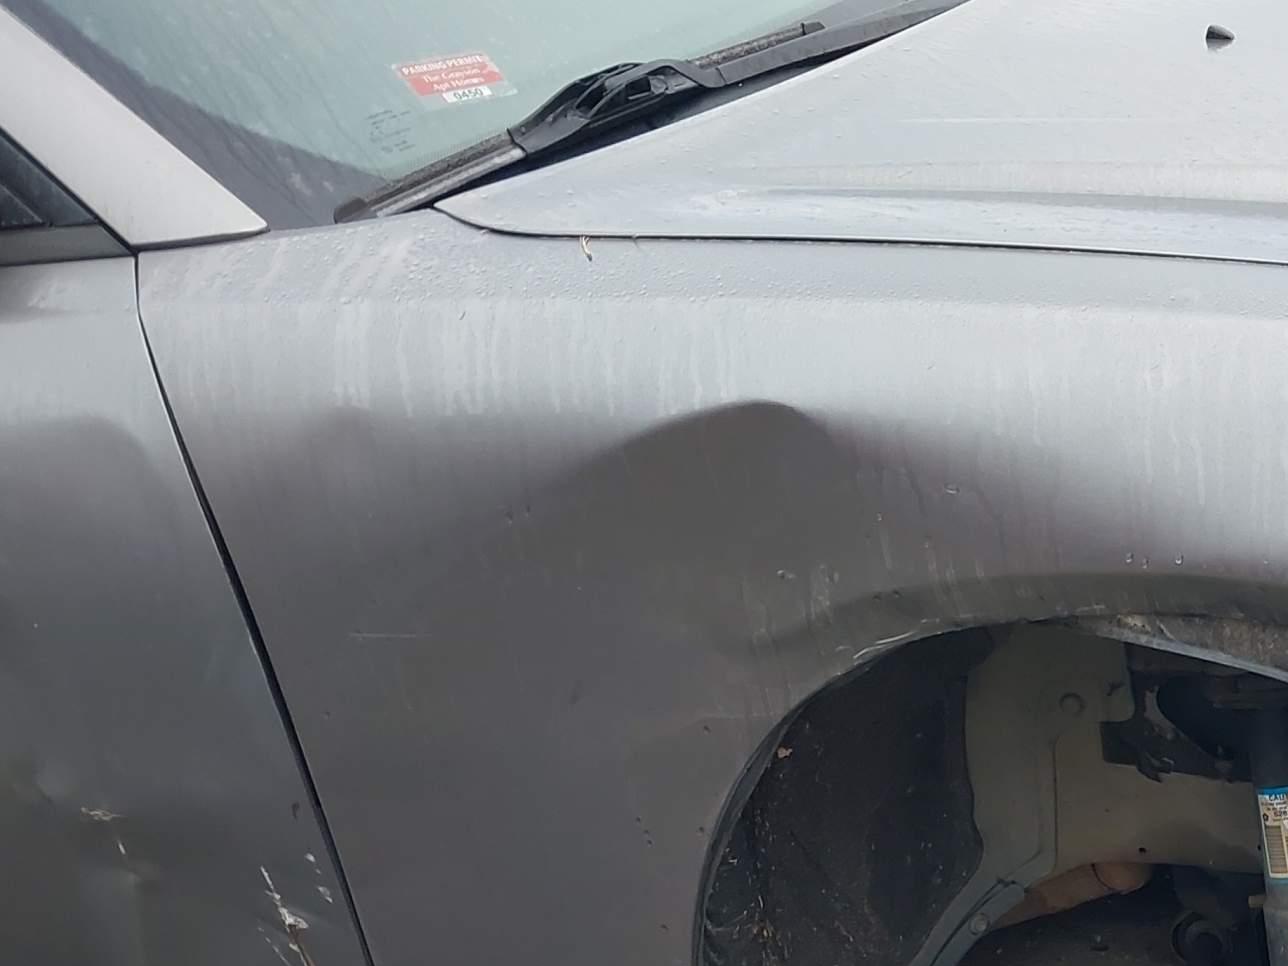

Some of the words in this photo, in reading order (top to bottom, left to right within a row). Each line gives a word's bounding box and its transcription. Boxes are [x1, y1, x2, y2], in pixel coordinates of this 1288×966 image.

[401, 62, 447, 76] PARKING
[447, 54, 483, 68] PERMIT
[453, 87, 484, 100] 0450
